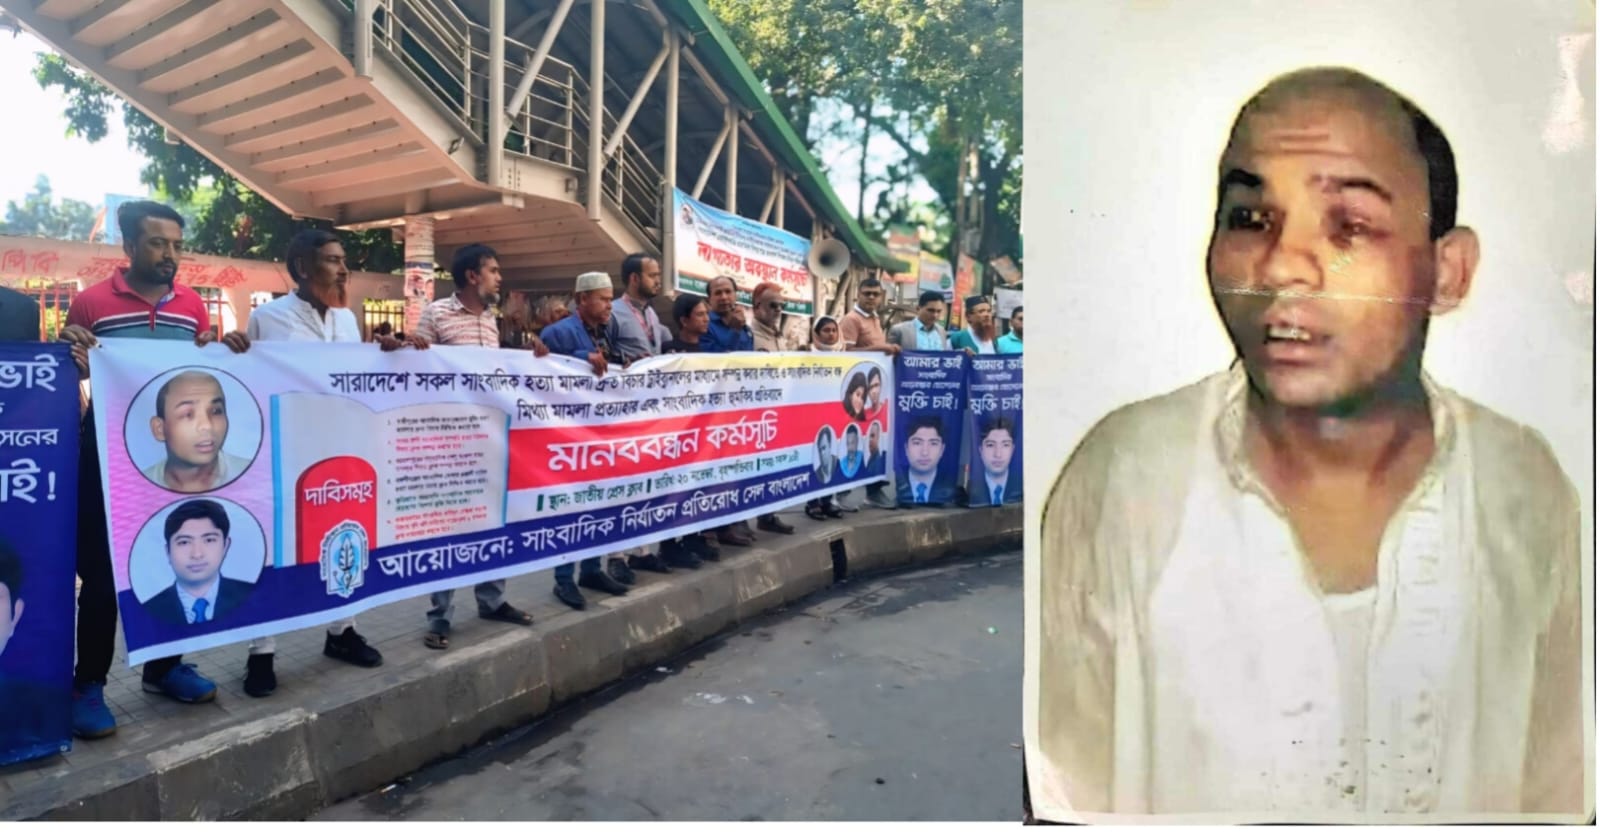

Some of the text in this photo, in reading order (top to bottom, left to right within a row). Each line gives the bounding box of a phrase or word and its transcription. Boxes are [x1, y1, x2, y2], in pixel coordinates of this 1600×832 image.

[903, 356, 939, 368] আমার
[328, 371, 410, 393] সারাদেশে
[414, 372, 456, 392] সকল
[460, 367, 521, 392] সাংবাদিক
[524, 374, 554, 392] হত্যা
[558, 374, 592, 391] মামলা
[517, 398, 549, 421] মিথ্যা
[551, 403, 591, 421] মামলা
[594, 400, 638, 417] প্রত্যাহার
[662, 390, 706, 411] সাংবাদিক
[898, 391, 929, 412] মুক্তি
[970, 393, 998, 415] মুক্তি
[547, 410, 778, 473] মানববন্ধন কর্মসূচি
[304, 479, 374, 506] দাবিসমূহ
[573, 484, 605, 505] জাতীয়
[376, 535, 514, 579] আয়োজনে:
[521, 514, 616, 552] সাংবাদিক
[621, 502, 678, 534] নির্যাতন
[681, 489, 740, 518] প্রতিরোধ
[743, 483, 765, 504] সেল
[767, 472, 810, 496] বাংলাদেশ
